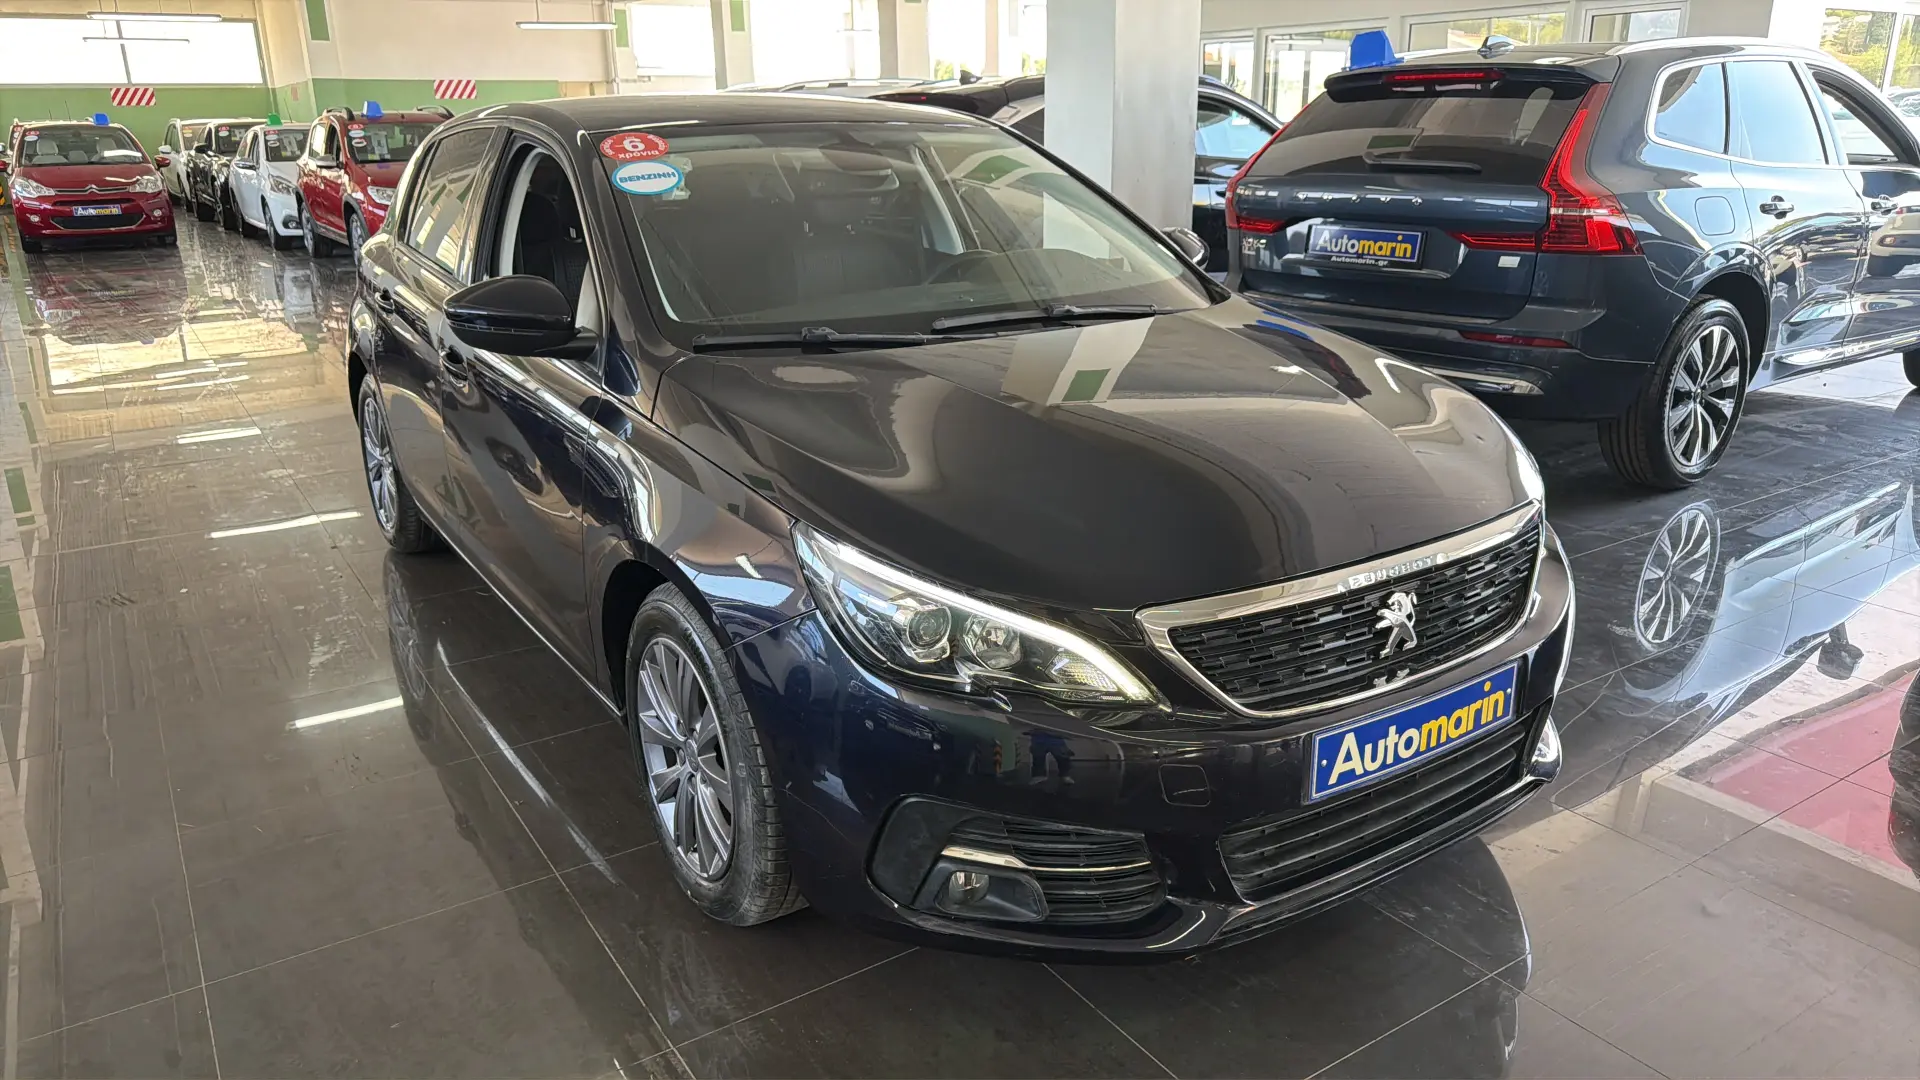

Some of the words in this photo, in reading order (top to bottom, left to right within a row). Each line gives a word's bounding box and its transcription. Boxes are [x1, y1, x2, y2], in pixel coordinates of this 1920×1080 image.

[618, 150, 660, 159] χρόνια
[77, 206, 119, 216] Automarin
[1315, 229, 1412, 258] Automarin
[1331, 255, 1388, 266] Automarin.gr
[1328, 680, 1505, 786] Automarin
